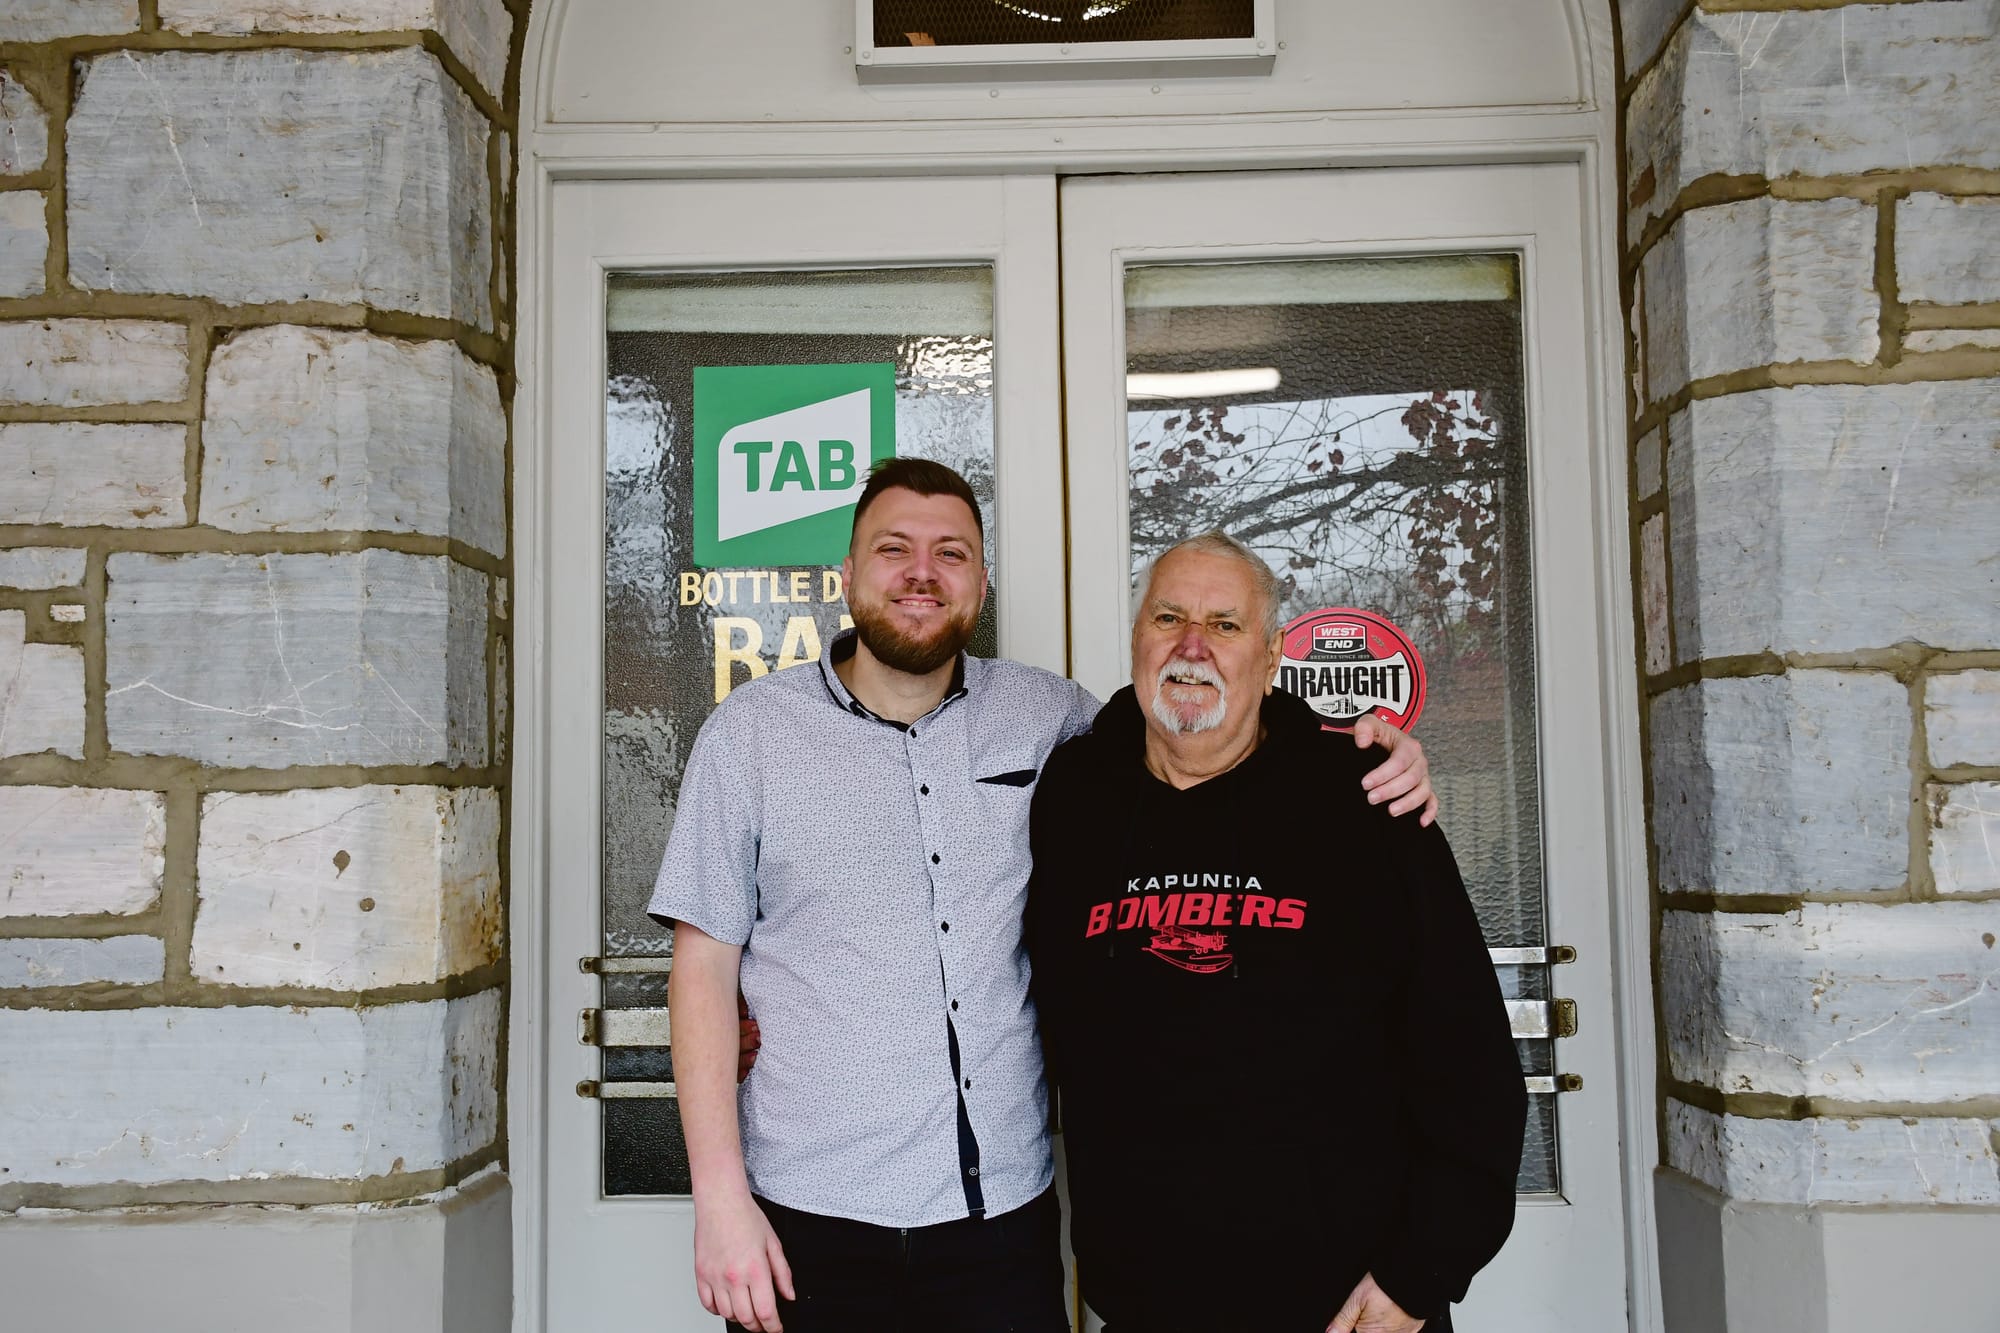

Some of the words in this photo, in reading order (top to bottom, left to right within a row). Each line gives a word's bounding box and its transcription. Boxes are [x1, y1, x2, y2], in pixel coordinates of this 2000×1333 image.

[733, 439, 857, 493] TAB
[680, 571, 810, 606] BOTTLE
[1321, 627, 1358, 637] WEST
[1324, 639, 1354, 649] END
[714, 614, 856, 704] BA
[1280, 664, 1405, 703] DRAUGHT
[1127, 872, 1263, 893] KAPUNDA
[1085, 892, 1308, 939] BOMBERS
